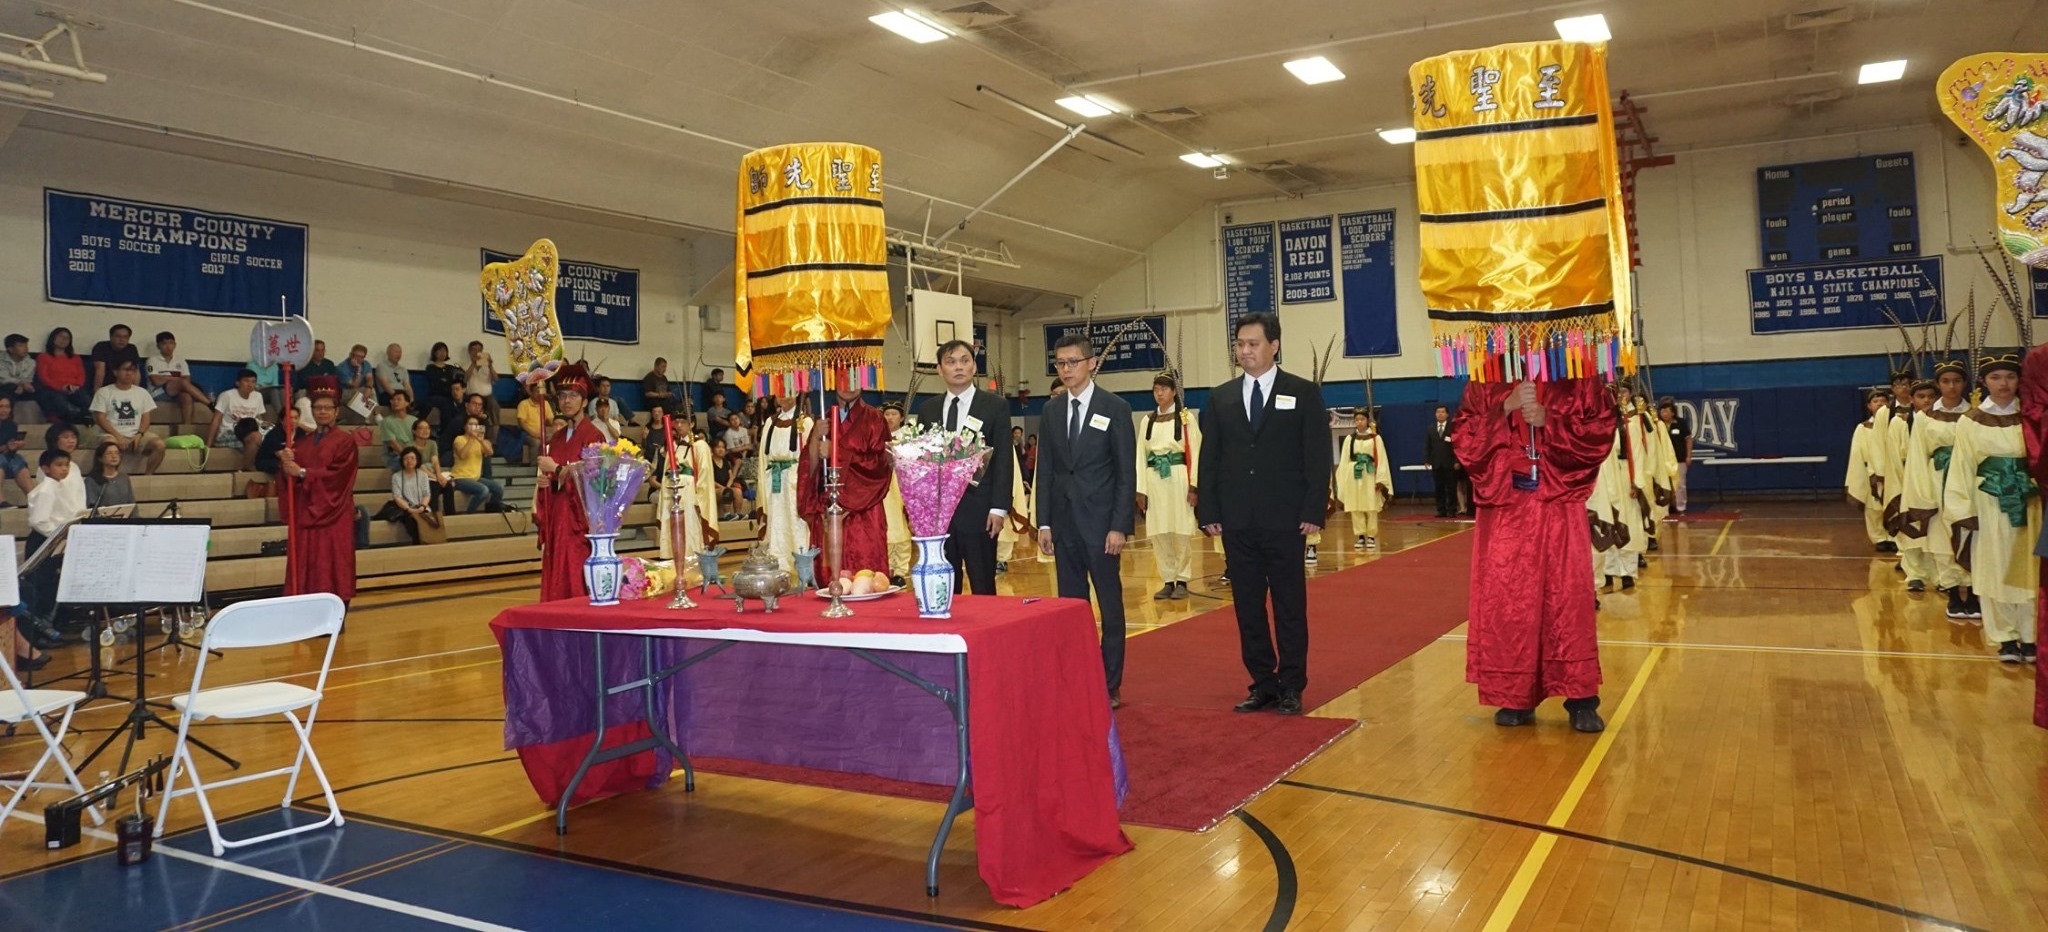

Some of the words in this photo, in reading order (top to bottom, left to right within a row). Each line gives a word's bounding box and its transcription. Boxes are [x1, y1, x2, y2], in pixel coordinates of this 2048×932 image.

[1875, 157, 1910, 169] Guests
[1765, 170, 1790, 180] Home
[1822, 196, 1851, 208] period
[1888, 207, 1912, 217] fouls
[89, 201, 182, 228] MERCER
[193, 217, 276, 240] COUNTY
[1341, 213, 1393, 226] BASKETBALL
[1766, 218, 1787, 228] fouls
[1822, 213, 1852, 224] player
[1281, 219, 1330, 231] BASKETBALL
[1368, 223, 1392, 233] POINT
[123, 223, 248, 252] CHAMPIONS
[1226, 226, 1270, 238] BASKETBALL
[1350, 232, 1386, 244] SCORERS
[81, 235, 111, 248] BOYS
[118, 240, 161, 254] SOCCER
[1249, 235, 1270, 245] POINT
[1285, 235, 1327, 251] DAVON
[1235, 245, 1264, 254] SCORERS
[1827, 247, 1851, 258] game
[1893, 243, 1912, 252] won
[68, 248, 96, 260] 1983
[1289, 251, 1324, 266] REED
[1770, 252, 1788, 262] won
[69, 261, 95, 272] 2010
[210, 252, 239, 264] GIRLS
[246, 256, 283, 269] SOCCER
[201, 263, 224, 275] 2013
[568, 265, 618, 282] COUNTY
[1304, 269, 1330, 280] POINTS
[1765, 271, 1806, 284] BOYS
[1814, 264, 1923, 281] BASKETBALL
[556, 278, 601, 292] MPIONS
[1822, 281, 1854, 294] STATE
[1862, 277, 1921, 291] CHAMPIONS
[573, 290, 595, 303] FIELD
[602, 293, 631, 307] HOCKEY
[1286, 286, 1330, 300] 2009-2013
[1063, 326, 1088, 336] BOYS
[1093, 321, 1147, 335] LACROSSE
[1091, 335, 1110, 345] STATE
[1675, 399, 1739, 451] DAY
